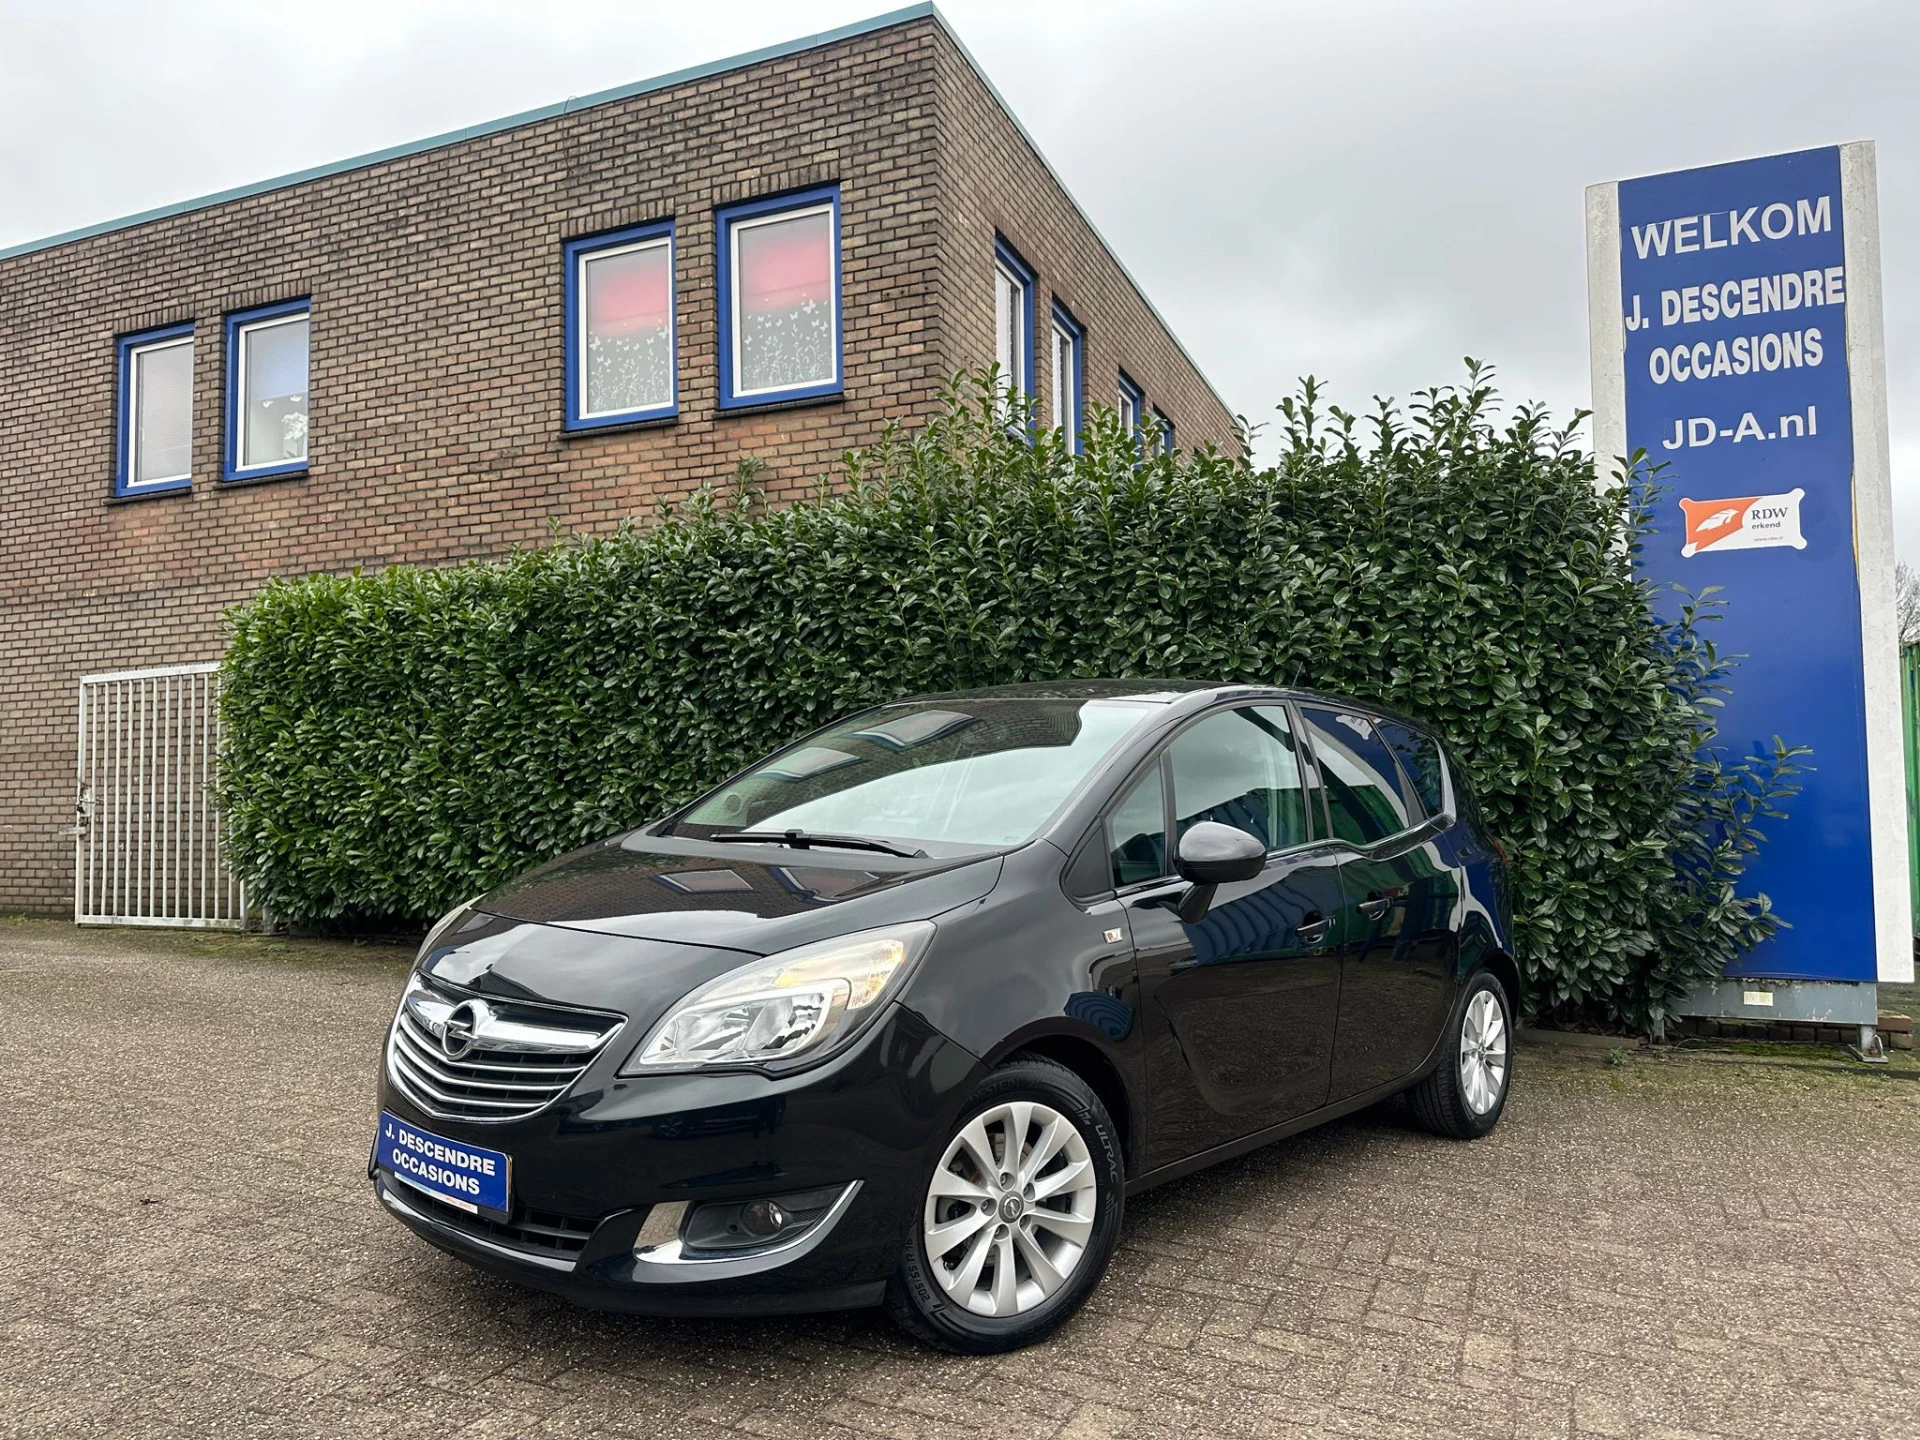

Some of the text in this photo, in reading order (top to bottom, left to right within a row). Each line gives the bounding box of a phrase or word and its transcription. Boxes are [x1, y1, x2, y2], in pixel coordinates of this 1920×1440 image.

[1631, 196, 1831, 260] WELKOM
[1625, 266, 1845, 332] J. DESCENDRE
[1649, 328, 1824, 385] OCCASIONS
[1662, 405, 1817, 450] JD-A.nl
[1751, 507, 1788, 520] RDW
[1751, 521, 1781, 530] erkend
[385, 1123, 496, 1176] J. DESCENDRE
[392, 1148, 480, 1195] OCCASIONS
[1095, 1124, 1119, 1184] ULTRAC
